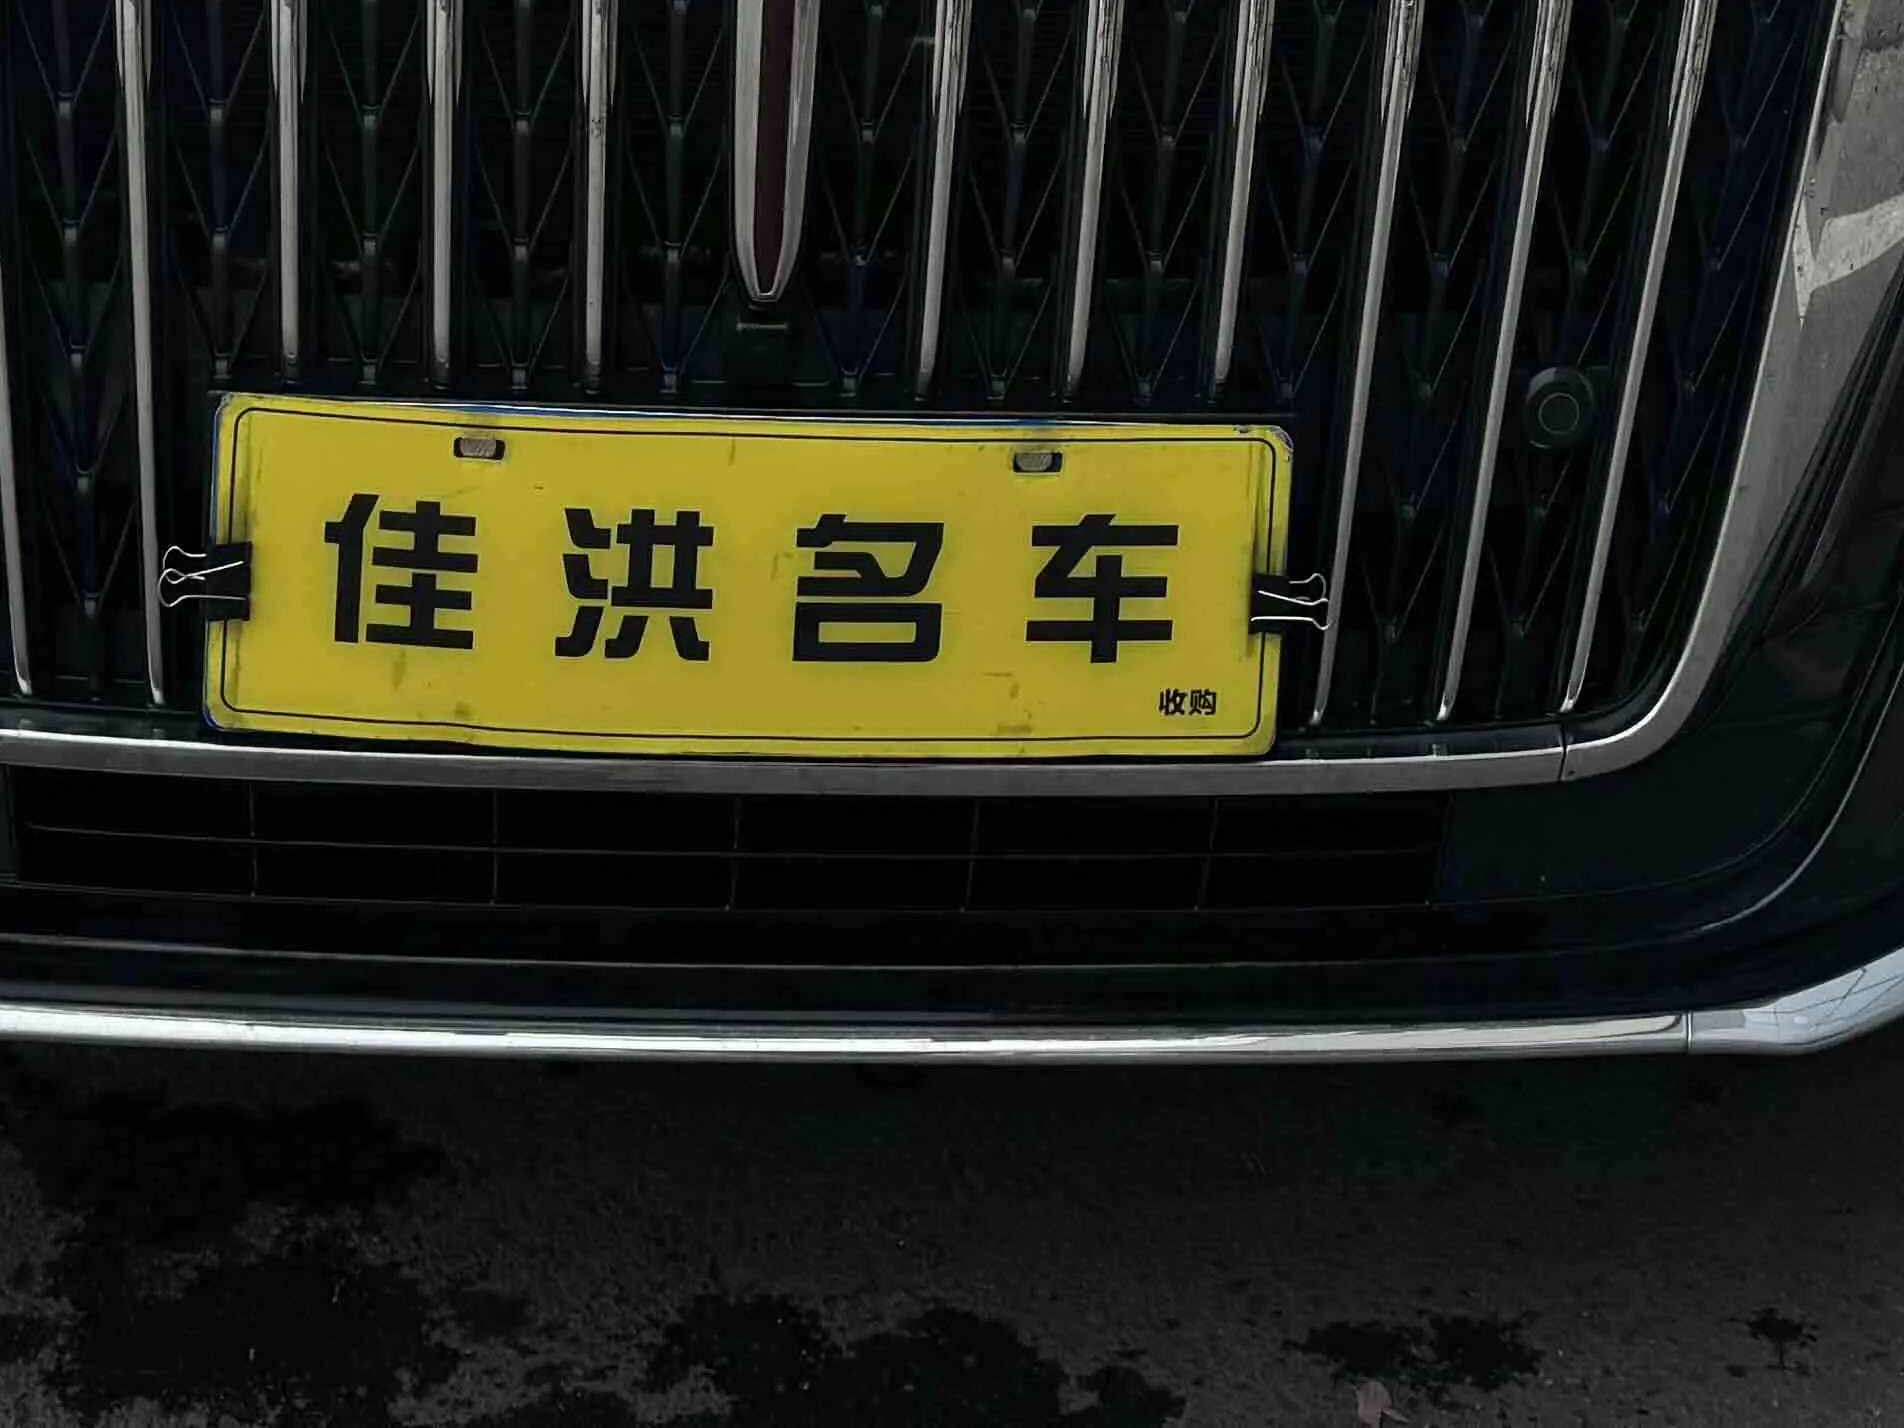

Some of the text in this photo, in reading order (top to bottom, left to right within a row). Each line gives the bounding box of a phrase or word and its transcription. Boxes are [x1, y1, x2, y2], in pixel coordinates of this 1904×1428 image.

[323, 492, 1180, 665] 佳洪名车
[1158, 687, 1218, 717] 收购
